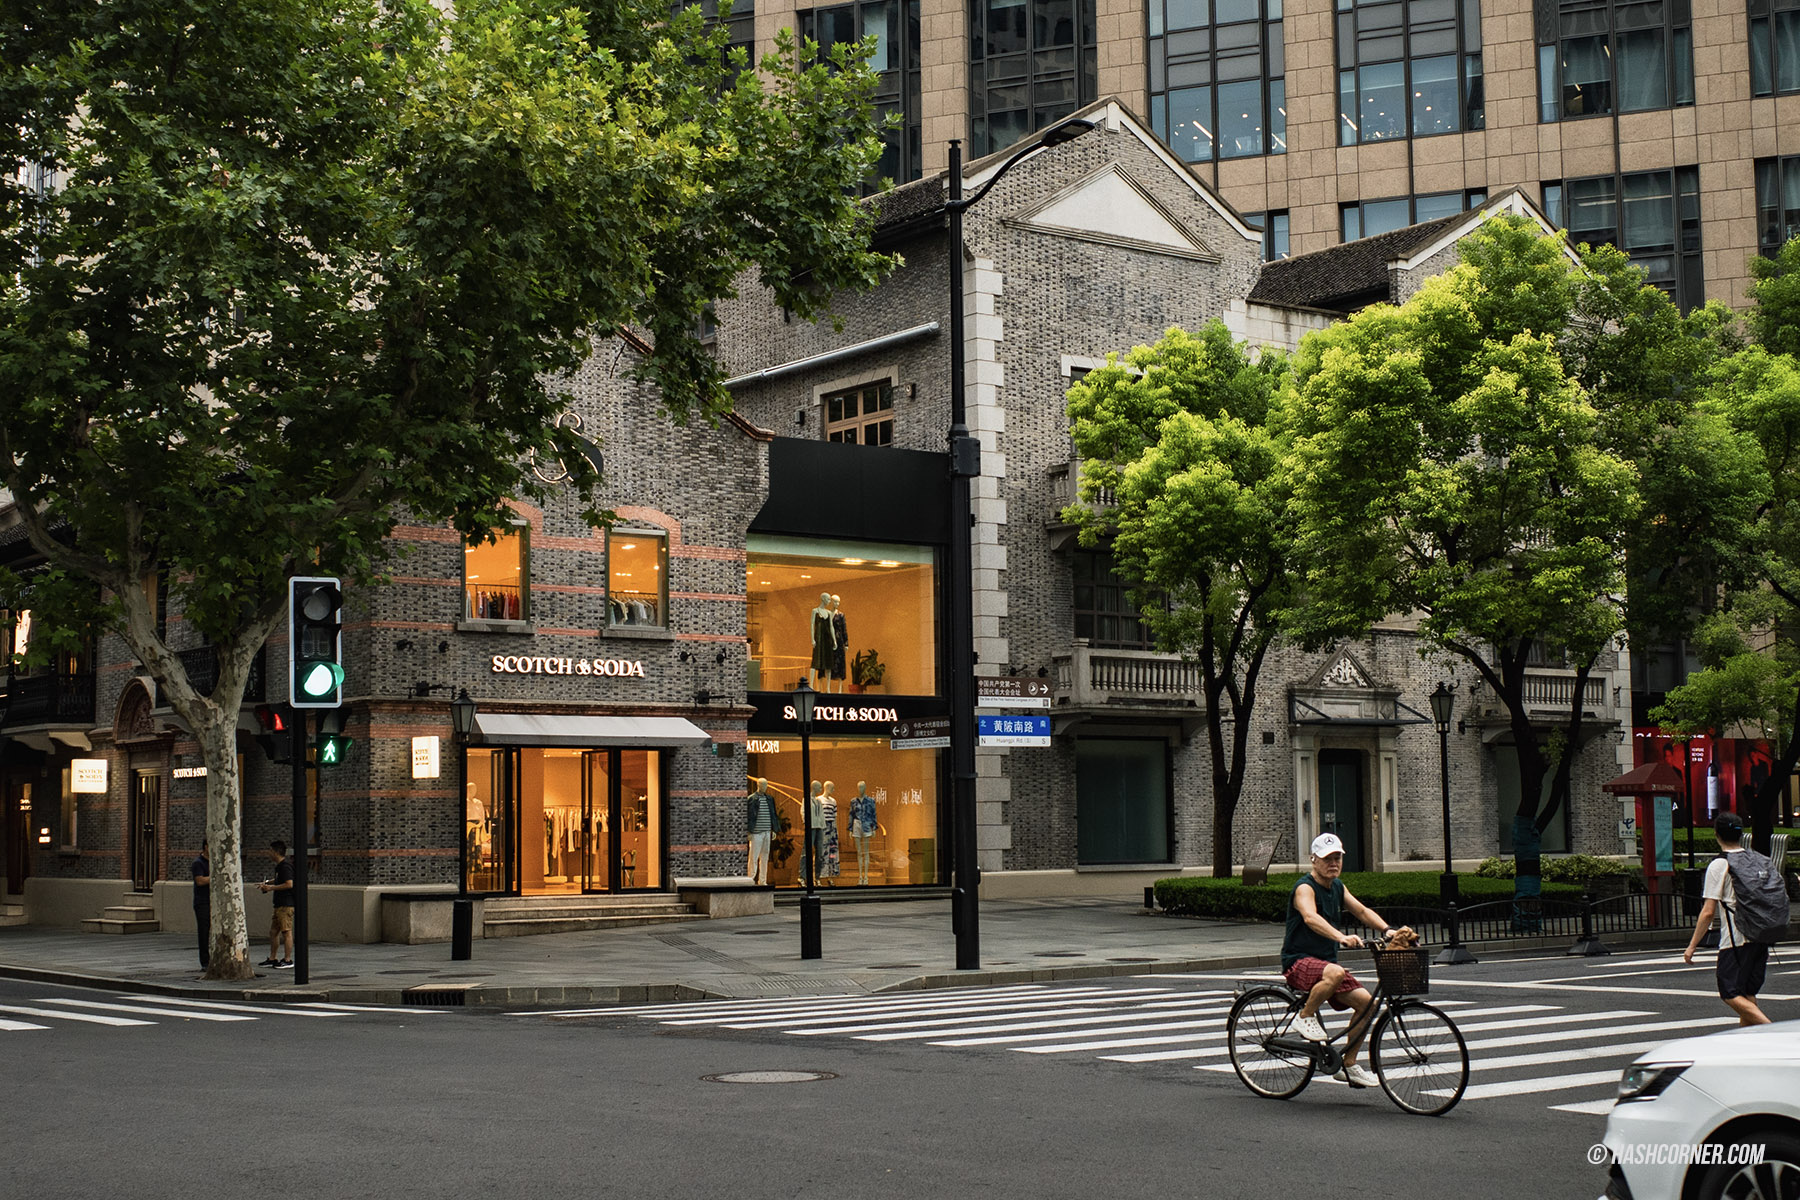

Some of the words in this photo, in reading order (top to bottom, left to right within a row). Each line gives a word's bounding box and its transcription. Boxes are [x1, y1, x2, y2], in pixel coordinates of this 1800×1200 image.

[491, 655, 573, 675] SCOTCH
[574, 658, 591, 675] &
[592, 659, 645, 678] SODA
[783, 705, 844, 721] STCH
[845, 707, 857, 721] &
[859, 708, 898, 722] SODA
[993, 720, 1033, 733] 黄陂南路
